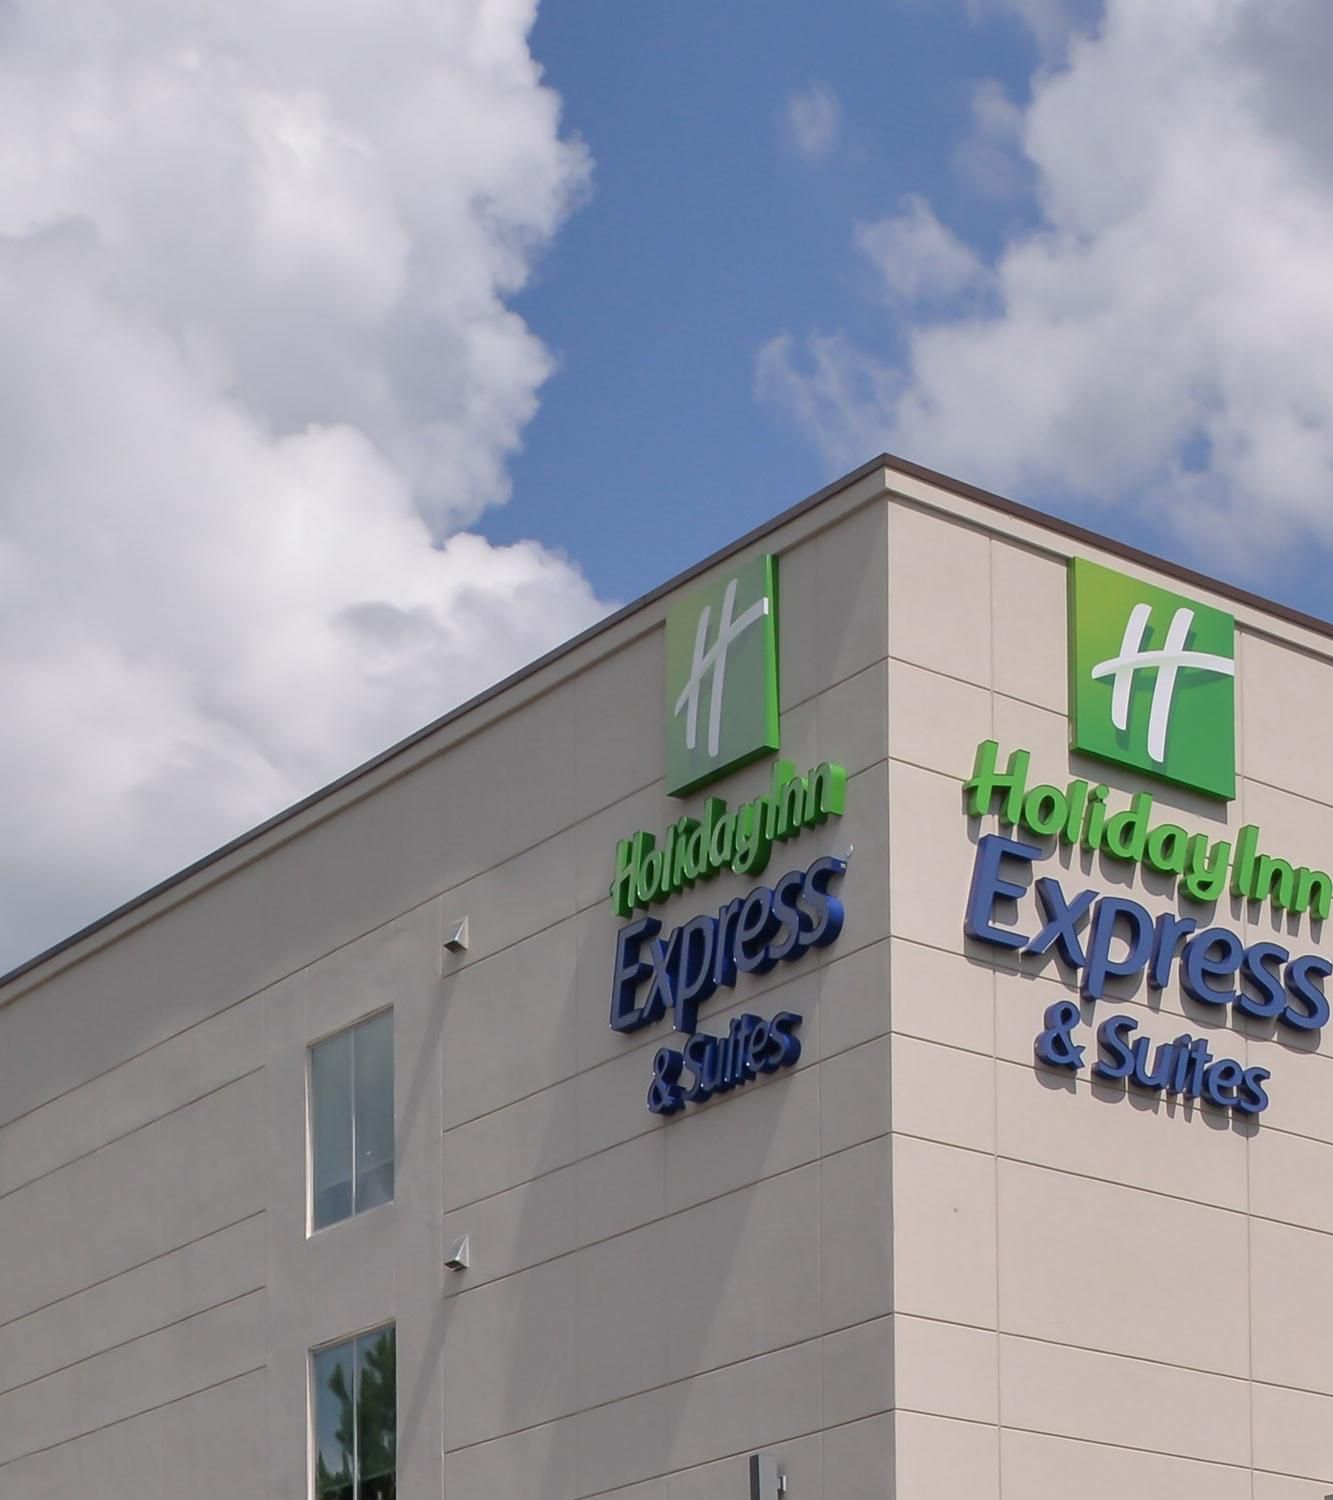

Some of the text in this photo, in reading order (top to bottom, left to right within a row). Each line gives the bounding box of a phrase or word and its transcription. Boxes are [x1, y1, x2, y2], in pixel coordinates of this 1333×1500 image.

[610, 859, 847, 1034] Express
[963, 834, 1333, 1031] Express
[647, 1011, 803, 1115] & Suites
[1034, 1000, 1271, 1114] & Suites
